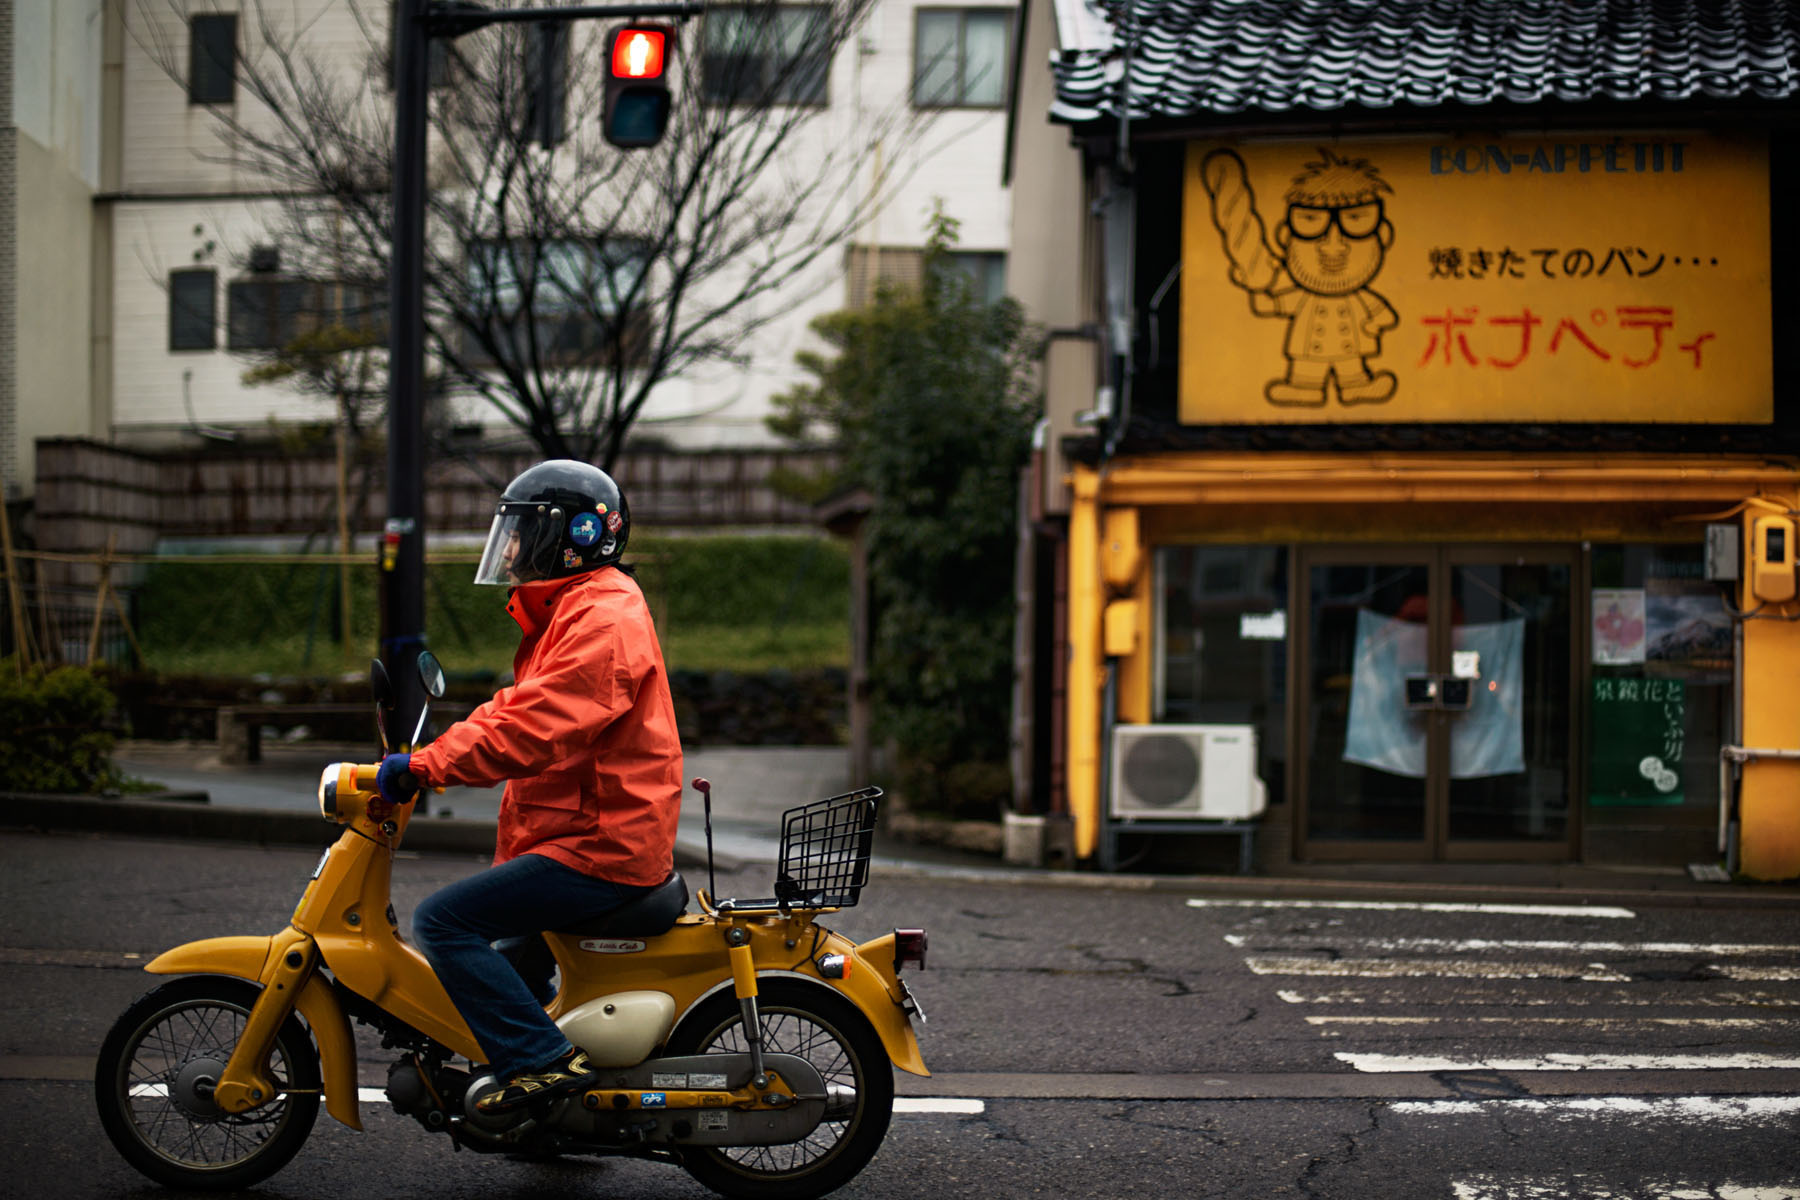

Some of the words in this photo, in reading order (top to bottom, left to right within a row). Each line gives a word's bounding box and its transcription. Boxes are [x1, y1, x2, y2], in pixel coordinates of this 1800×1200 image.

[1418, 306, 1716, 370] ボナペティ
